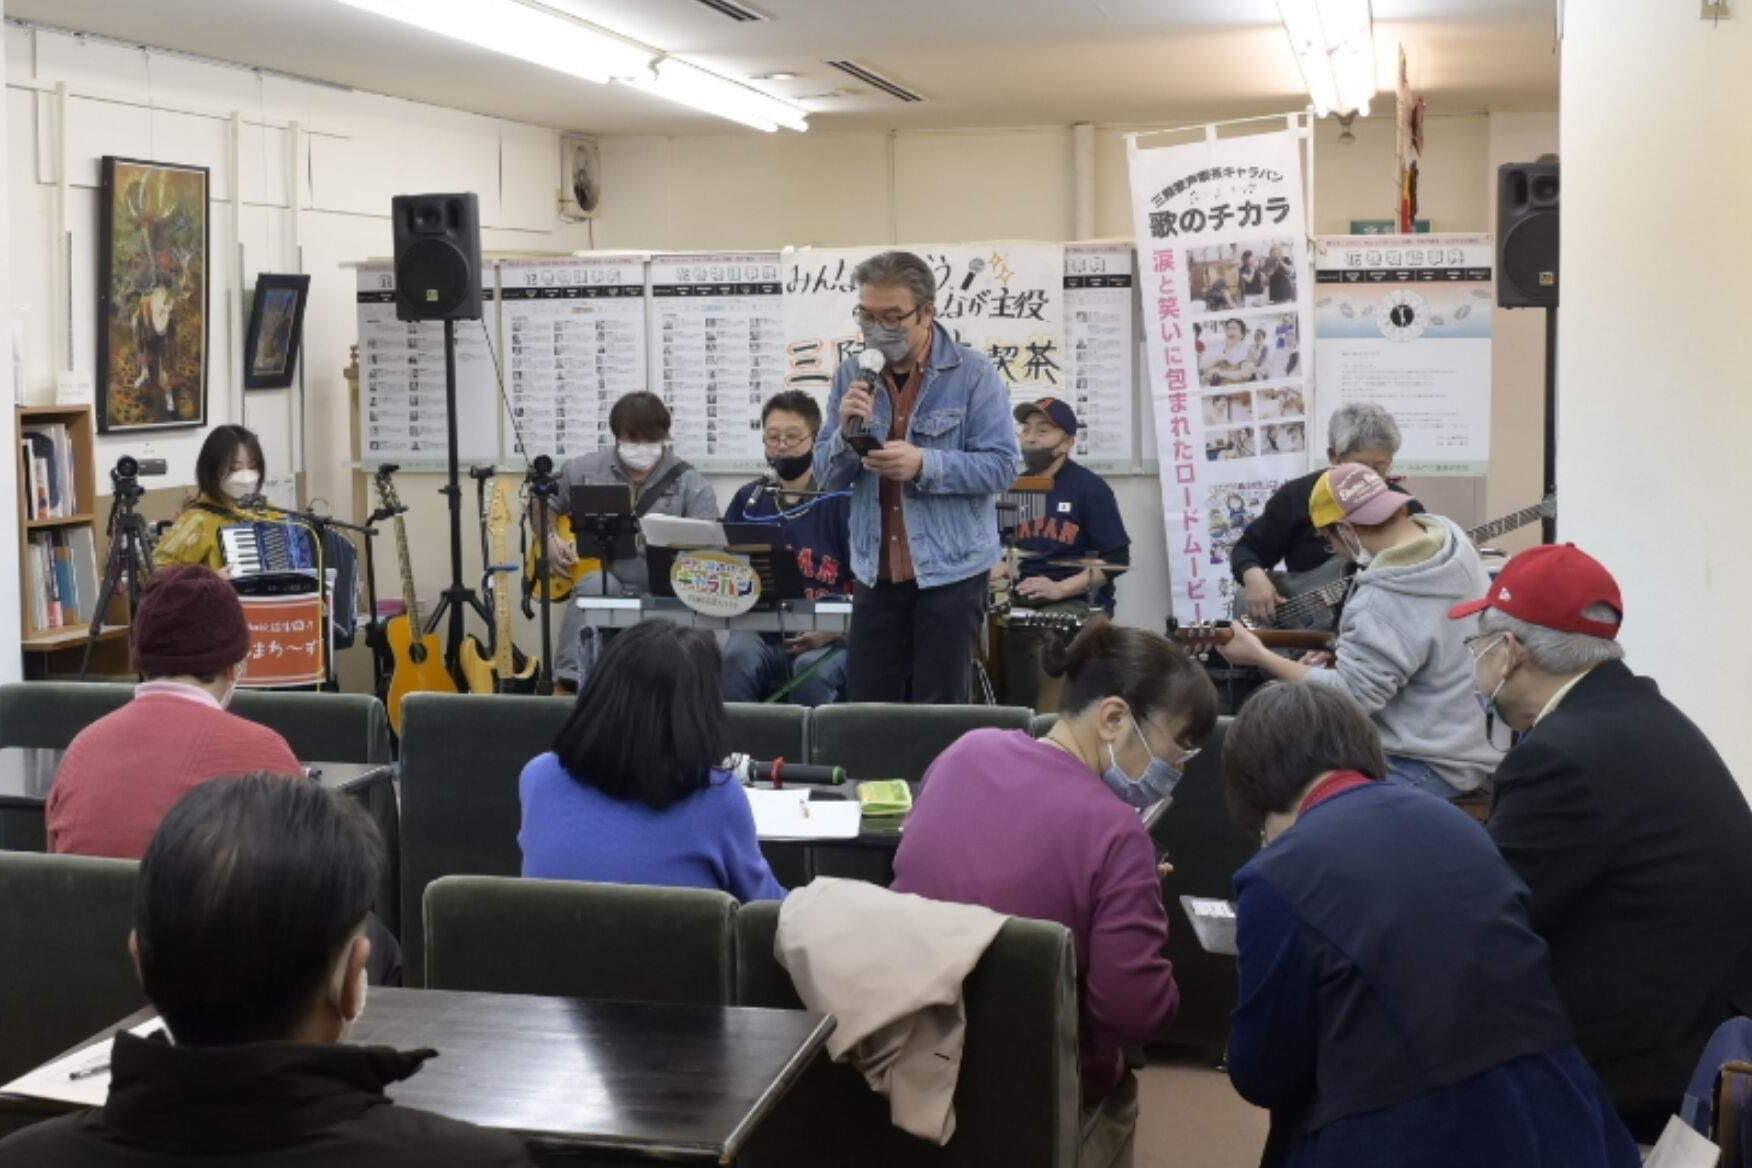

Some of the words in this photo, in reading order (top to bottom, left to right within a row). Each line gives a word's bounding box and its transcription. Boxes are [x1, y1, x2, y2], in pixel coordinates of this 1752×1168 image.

[1149, 197, 1290, 238] 歌のチカラ
[939, 287, 1050, 323] なが主役
[1152, 249, 1207, 621] 涙と笑いに包まれたロードムービー
[1018, 518, 1080, 544] APAN
